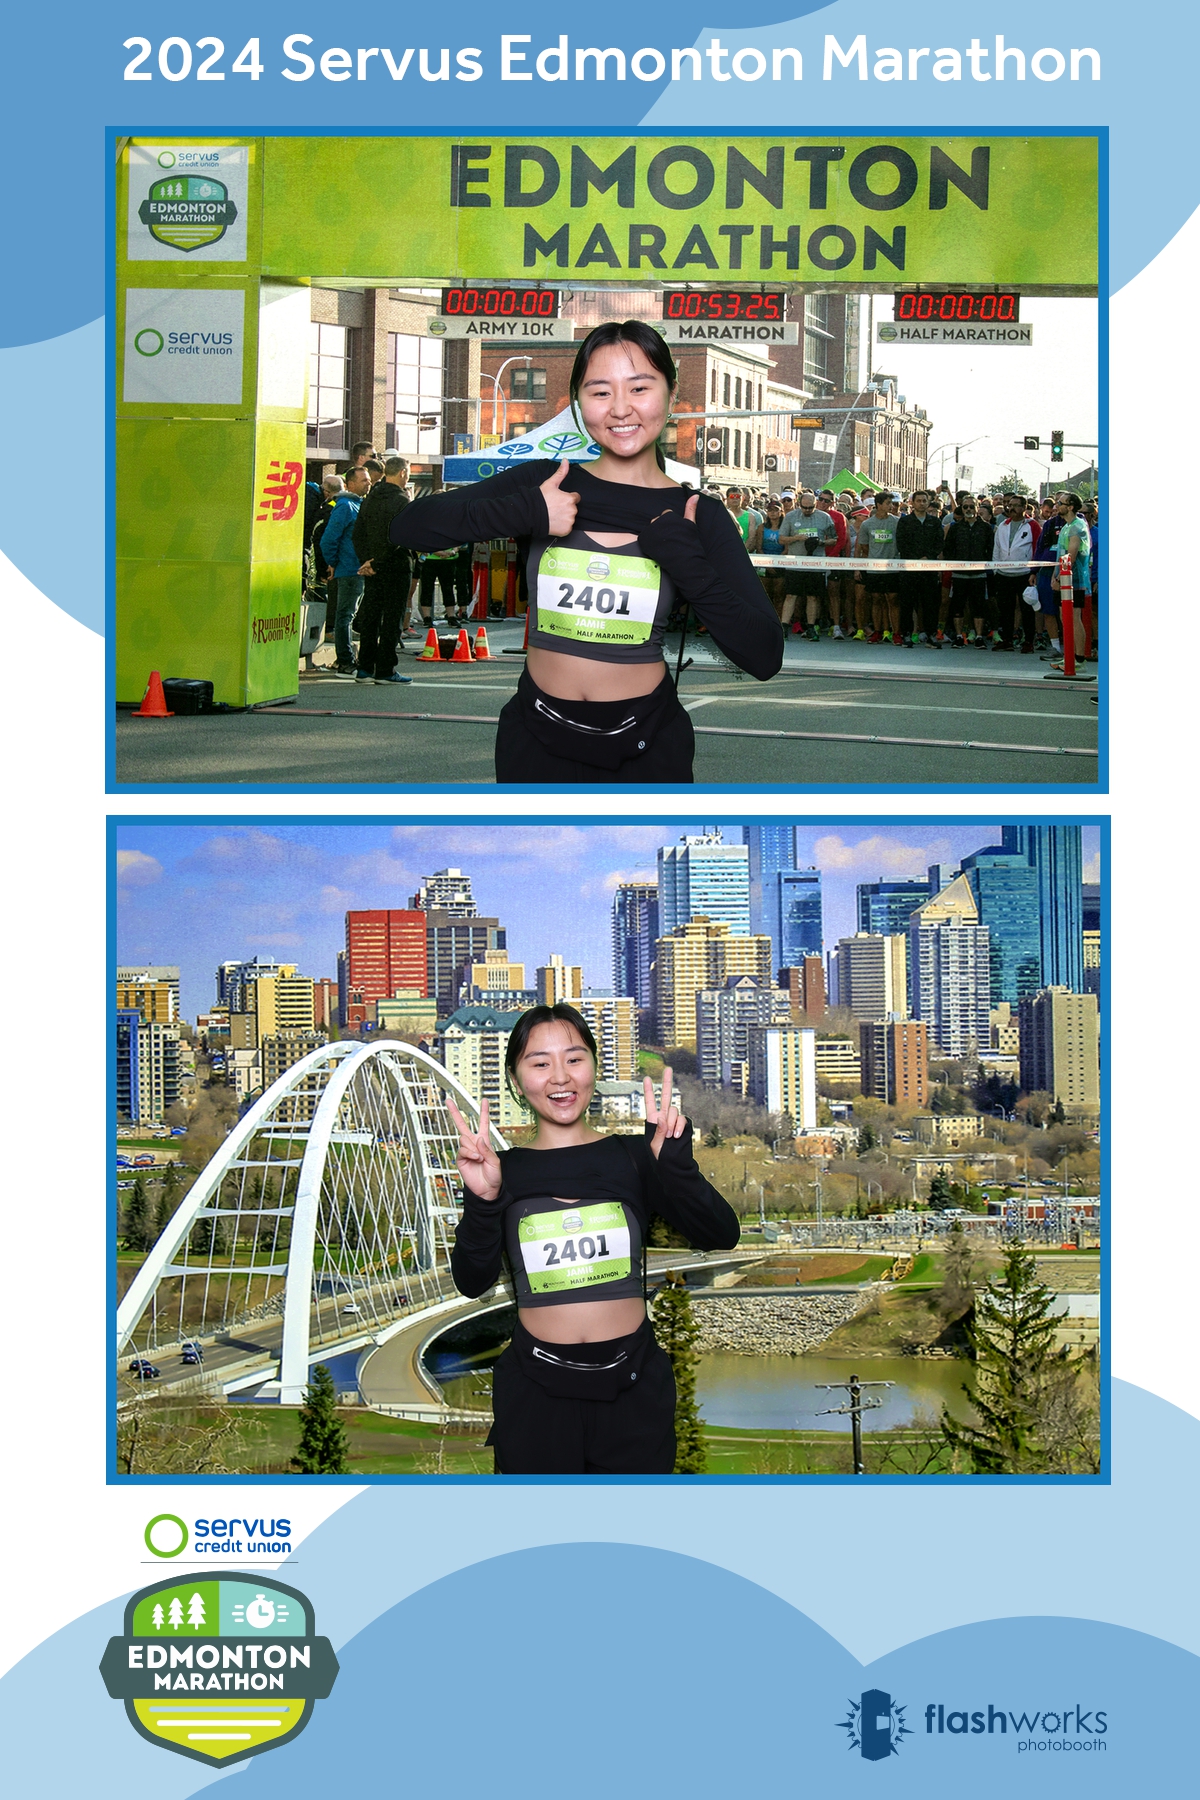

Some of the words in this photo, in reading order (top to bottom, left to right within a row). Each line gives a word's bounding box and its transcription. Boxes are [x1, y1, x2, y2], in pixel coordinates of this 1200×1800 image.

[178, 152, 219, 161] servus
[449, 145, 991, 211] EDMONTON
[150, 203, 226, 214] EDMONTON
[160, 214, 215, 222] MARATHON
[522, 222, 907, 271] MARATHON
[465, 321, 518, 336] ARMY
[521, 323, 554, 336] 10K
[678, 325, 785, 340] MARATHON
[900, 328, 939, 339] HALF
[942, 329, 1031, 341] MARATHON
[168, 332, 232, 344] servus
[168, 345, 200, 355] credit
[203, 347, 233, 355] union
[557, 583, 630, 615] 2401
[257, 613, 290, 643] Running
[575, 618, 606, 630] JAMIE
[577, 630, 593, 638] HALF
[595, 631, 634, 640] MARATHON
[544, 1235, 610, 1266] 2401
[567, 1266, 593, 1277] JAMIE
[570, 1277, 586, 1285] HALF
[587, 1271, 619, 1282] MARATHON
